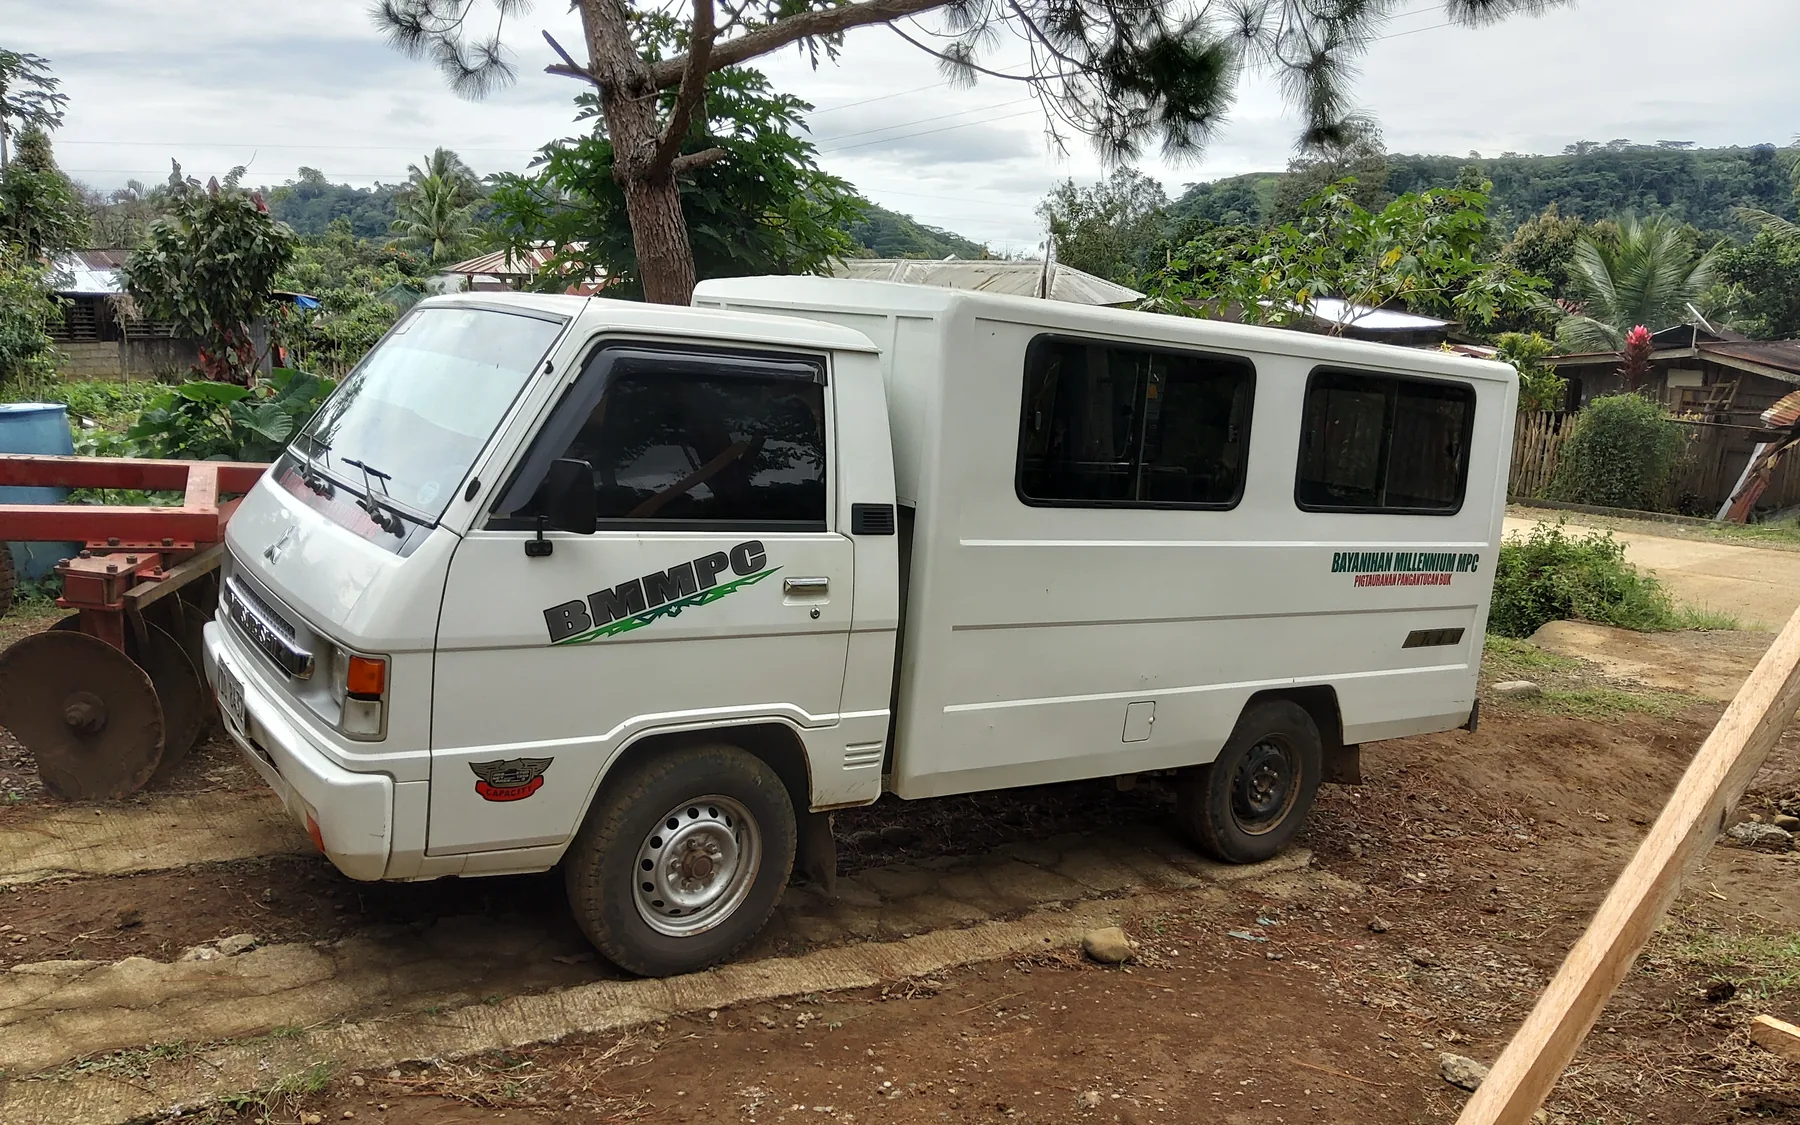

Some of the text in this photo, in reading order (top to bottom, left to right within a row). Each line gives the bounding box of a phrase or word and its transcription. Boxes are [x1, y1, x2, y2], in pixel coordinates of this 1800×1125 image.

[1331, 552, 1480, 573] BAYANIHAN MILLENNIUM MPC
[1396, 573, 1439, 586] PANGANTUCAN
[543, 540, 767, 643] BMMPC
[486, 785, 533, 797] CAPACITY
